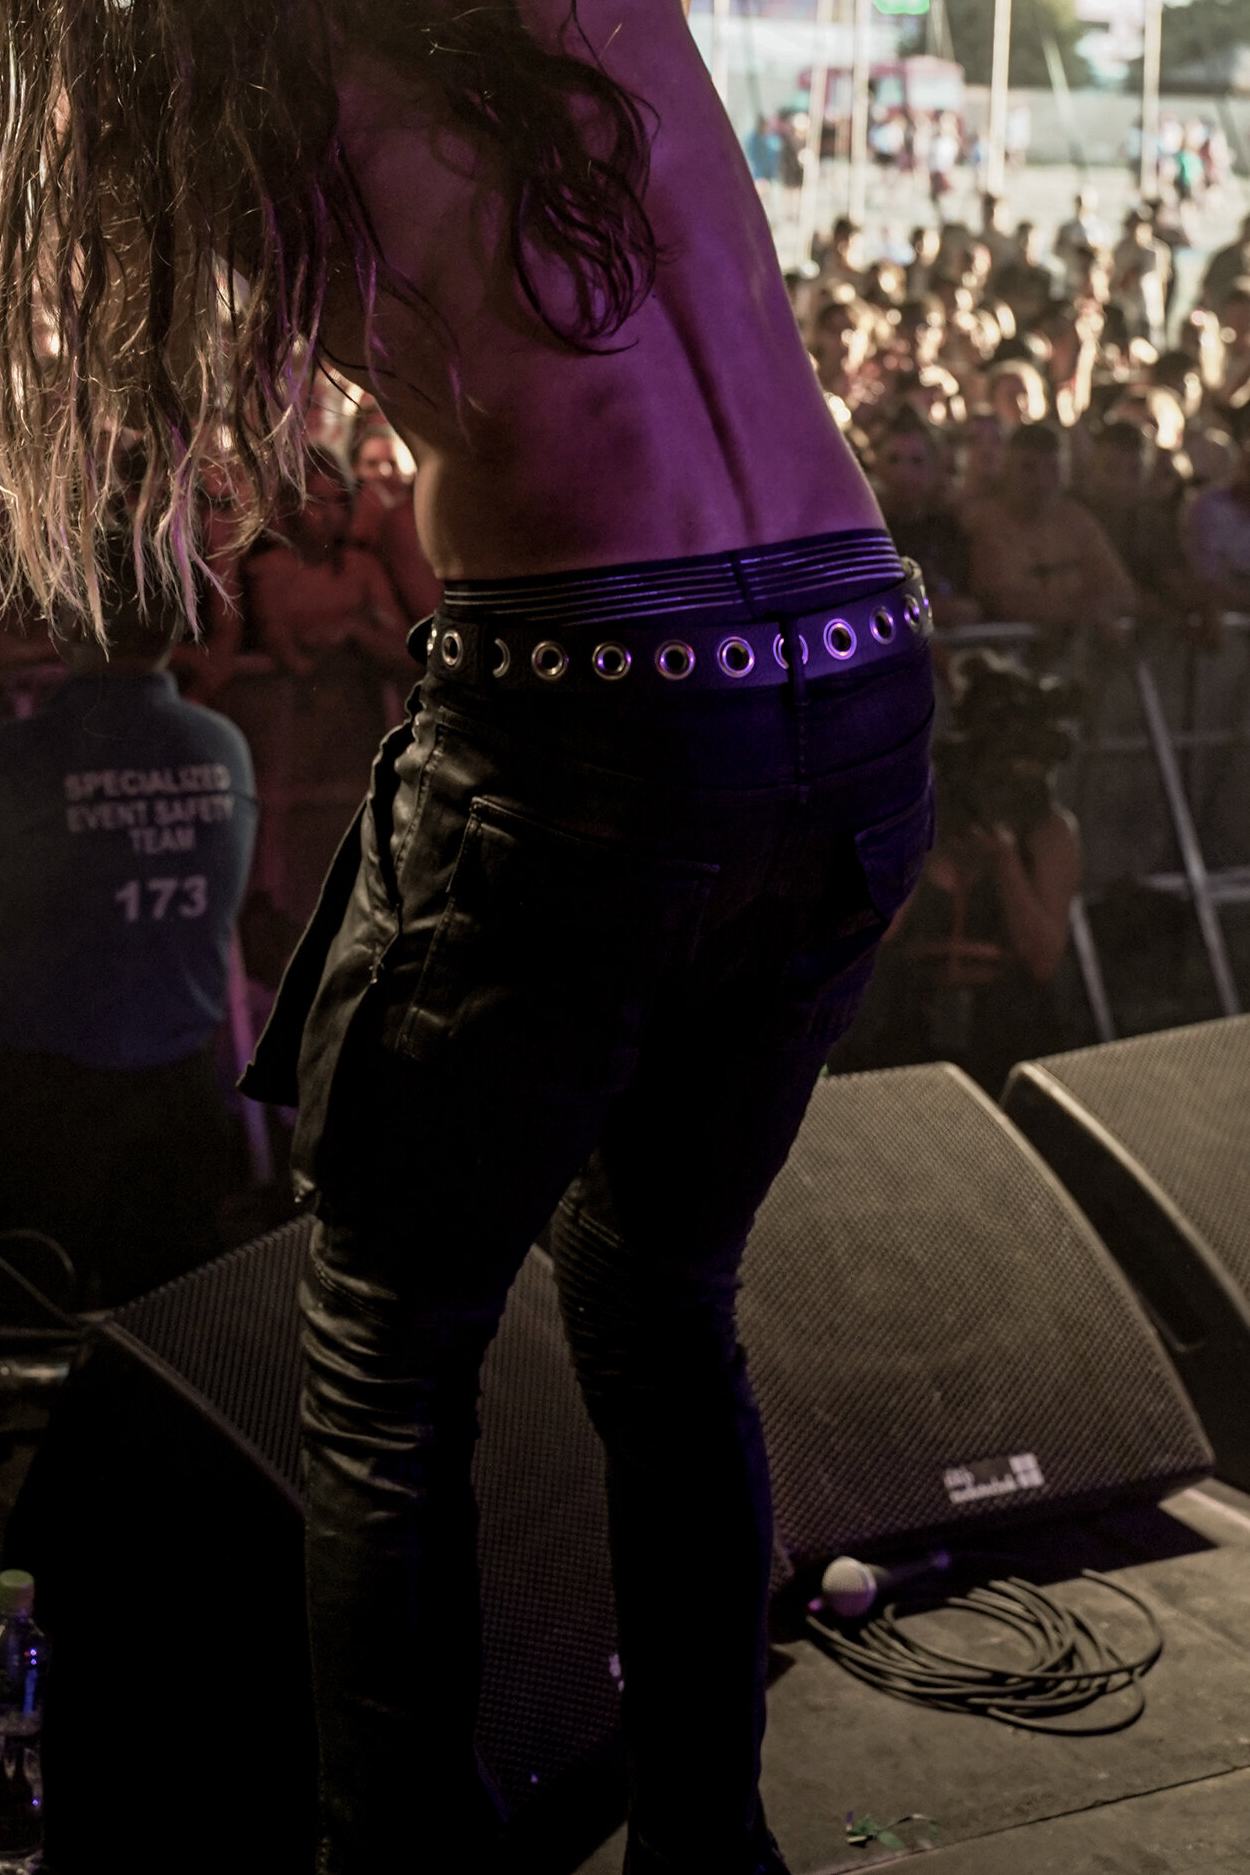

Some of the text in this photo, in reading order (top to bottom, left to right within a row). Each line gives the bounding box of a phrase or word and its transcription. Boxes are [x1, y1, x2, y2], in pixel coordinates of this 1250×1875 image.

[65, 763, 230, 800] SPECIALIZED
[67, 795, 234, 833] EVENT SAFETY
[130, 826, 196, 855] TEAM
[116, 875, 207, 923] 173
